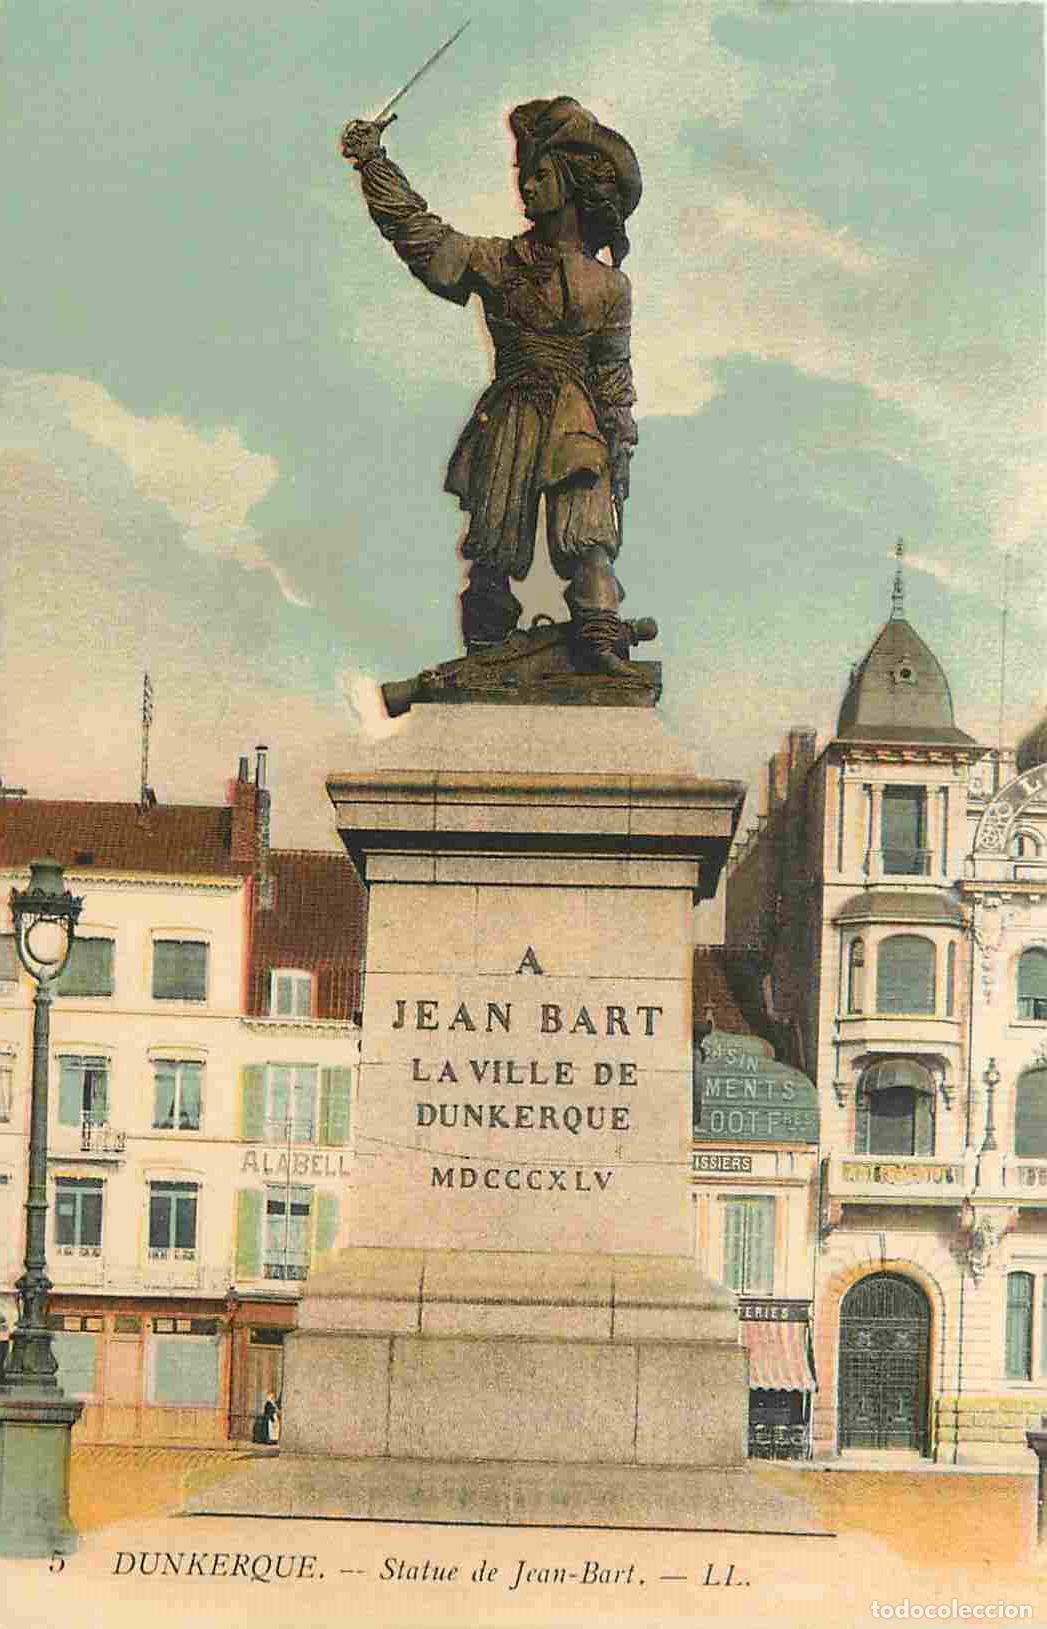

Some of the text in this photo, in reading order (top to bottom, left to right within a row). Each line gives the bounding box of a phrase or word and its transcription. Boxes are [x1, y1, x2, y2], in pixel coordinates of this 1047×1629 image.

[516, 946, 543, 974] A
[392, 999, 663, 1036] JEAN BART
[412, 1057, 638, 1086] LA VILLE DE
[416, 1103, 630, 1134] DUNKERQUE
[431, 1167, 613, 1191] MDCCCXLV
